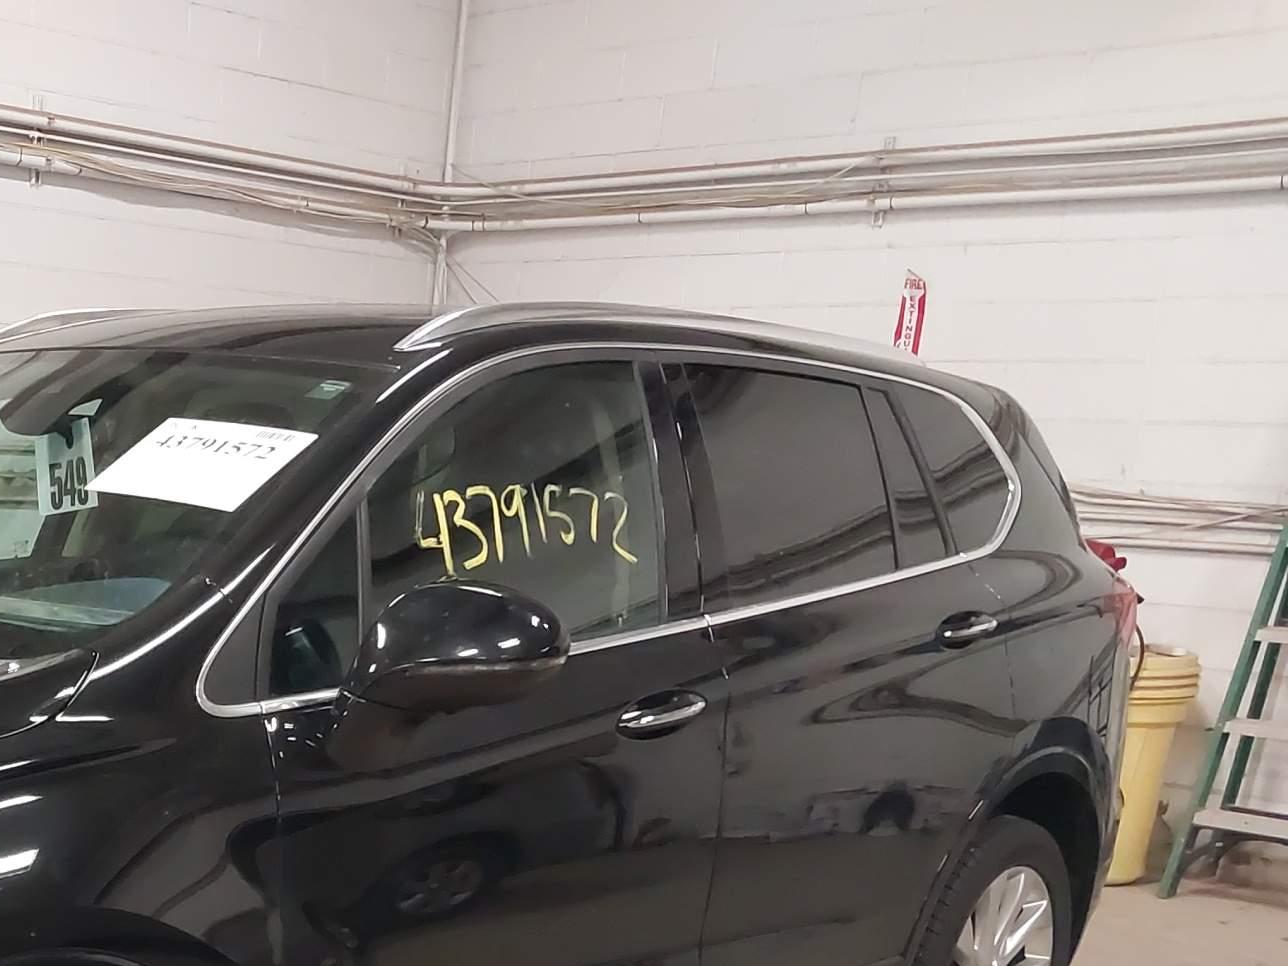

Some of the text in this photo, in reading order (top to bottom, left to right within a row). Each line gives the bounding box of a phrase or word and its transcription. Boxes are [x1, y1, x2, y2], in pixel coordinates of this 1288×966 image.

[903, 278, 923, 290] FIRE
[155, 434, 276, 460] 43791572
[49, 456, 89, 510] 549
[415, 482, 638, 578] 43791572
